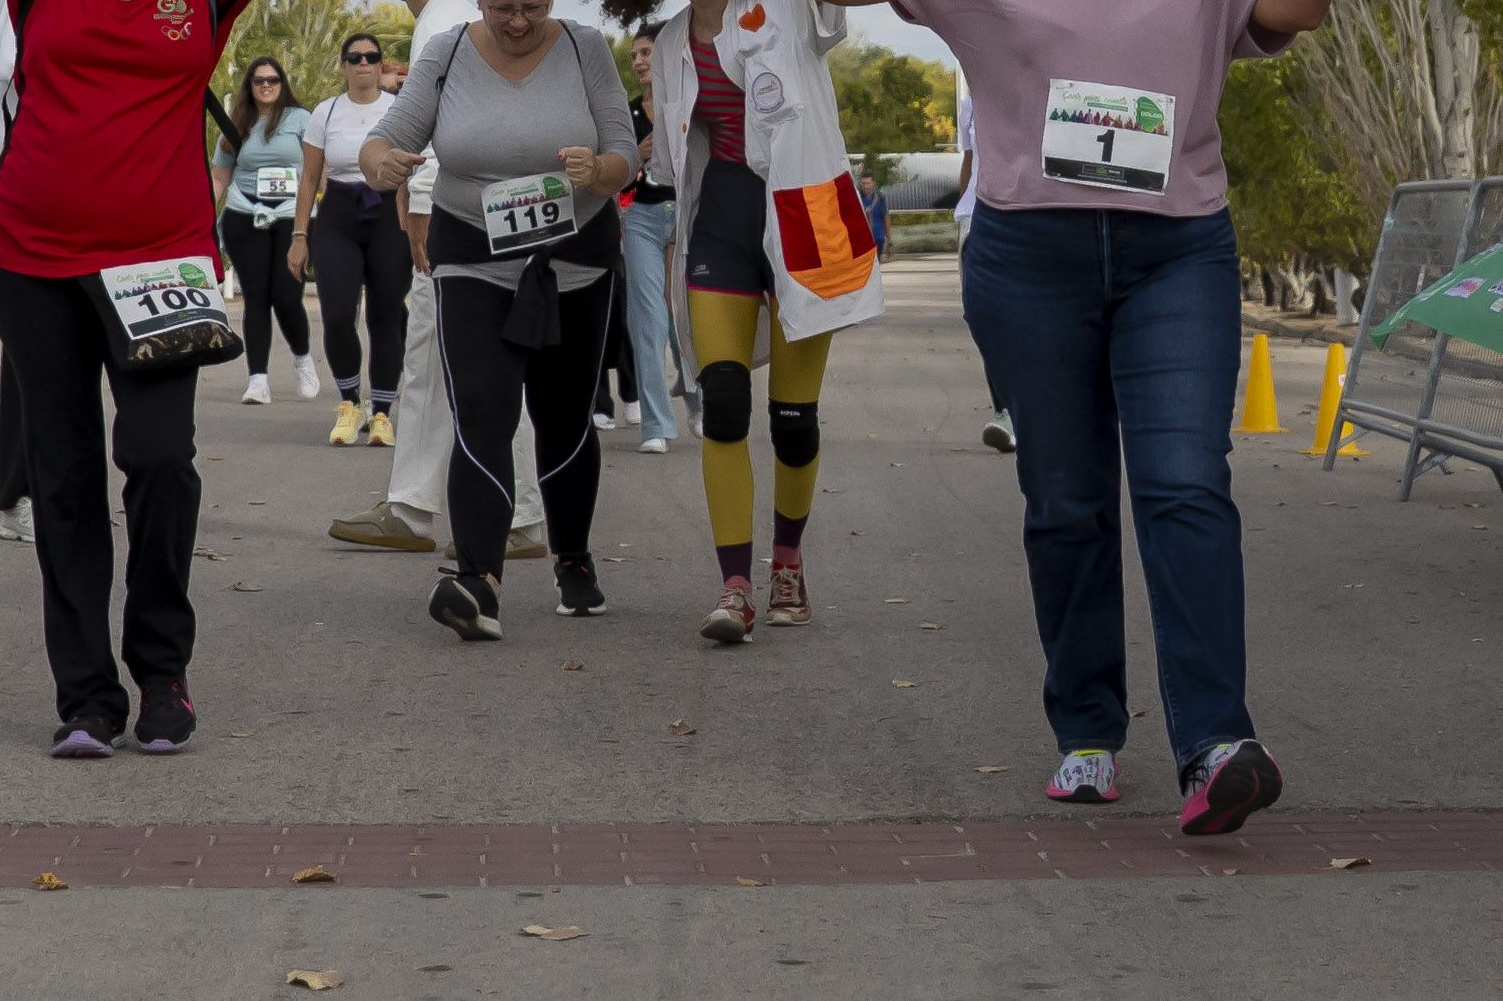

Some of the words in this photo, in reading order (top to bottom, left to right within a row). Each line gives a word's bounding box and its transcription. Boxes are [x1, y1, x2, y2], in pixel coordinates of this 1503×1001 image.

[1096, 129, 1116, 163] 1
[269, 180, 287, 193] 55
[503, 201, 560, 233] 119
[137, 289, 211, 316] 100
